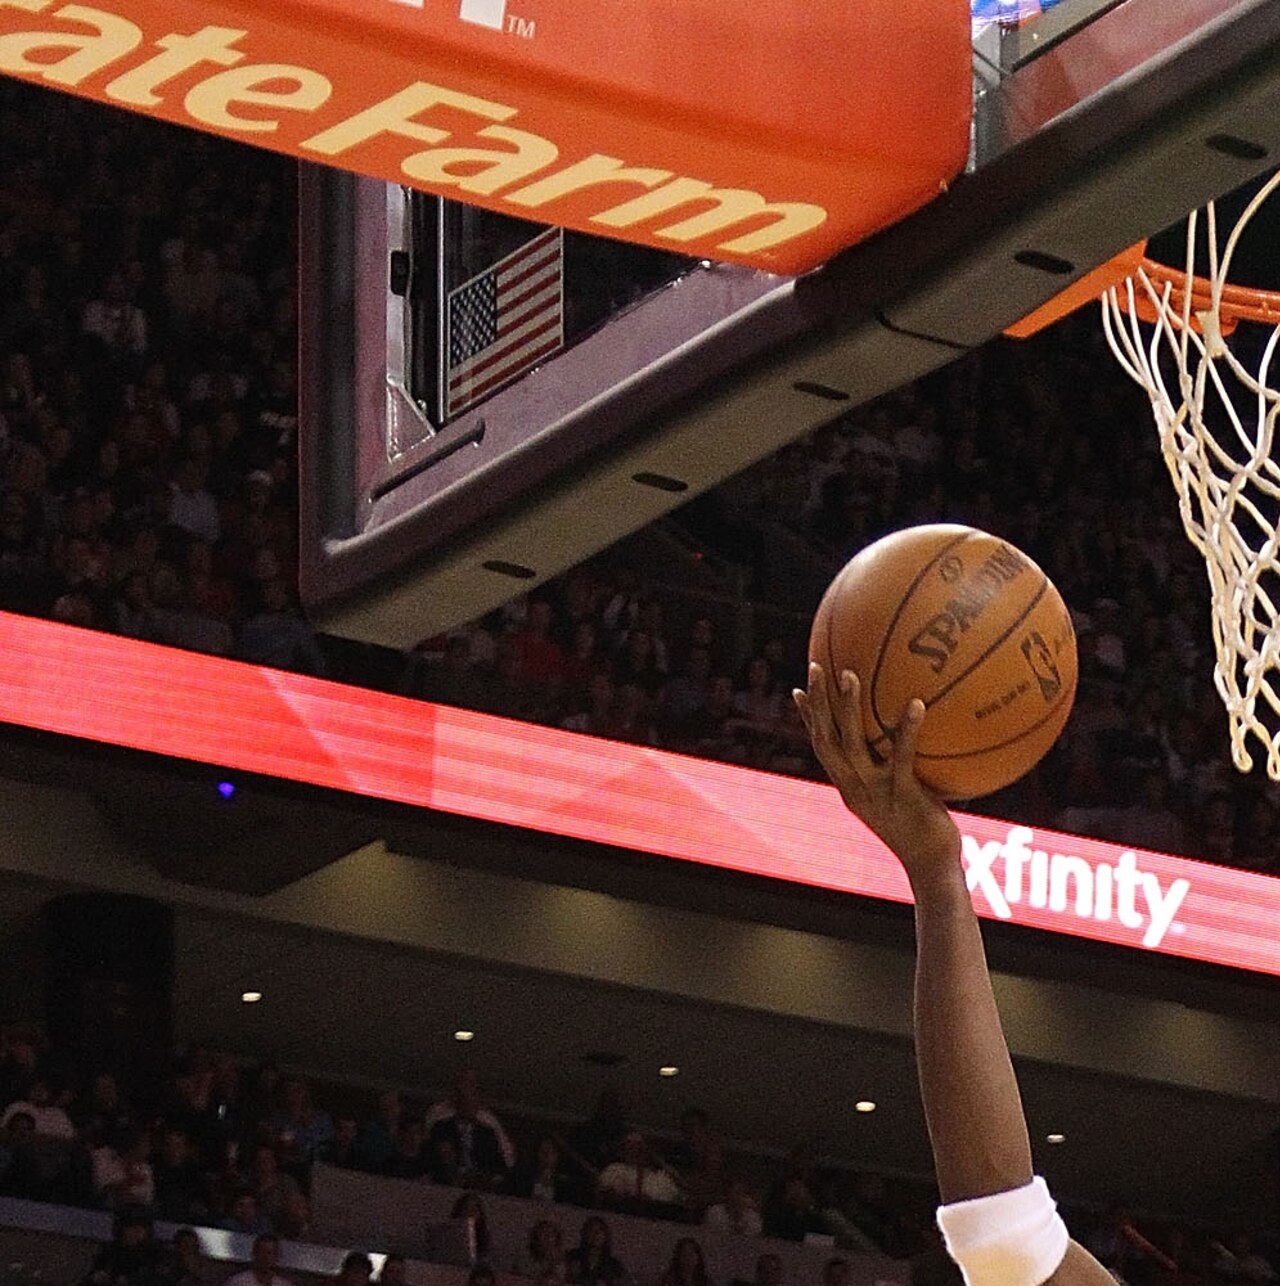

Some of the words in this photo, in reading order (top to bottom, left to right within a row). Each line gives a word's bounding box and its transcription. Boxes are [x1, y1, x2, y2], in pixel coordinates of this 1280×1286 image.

[507, 14, 536, 39] TM
[0, 0, 332, 132] ate
[299, 81, 828, 255] Farm
[960, 826, 1191, 948] xfinity
